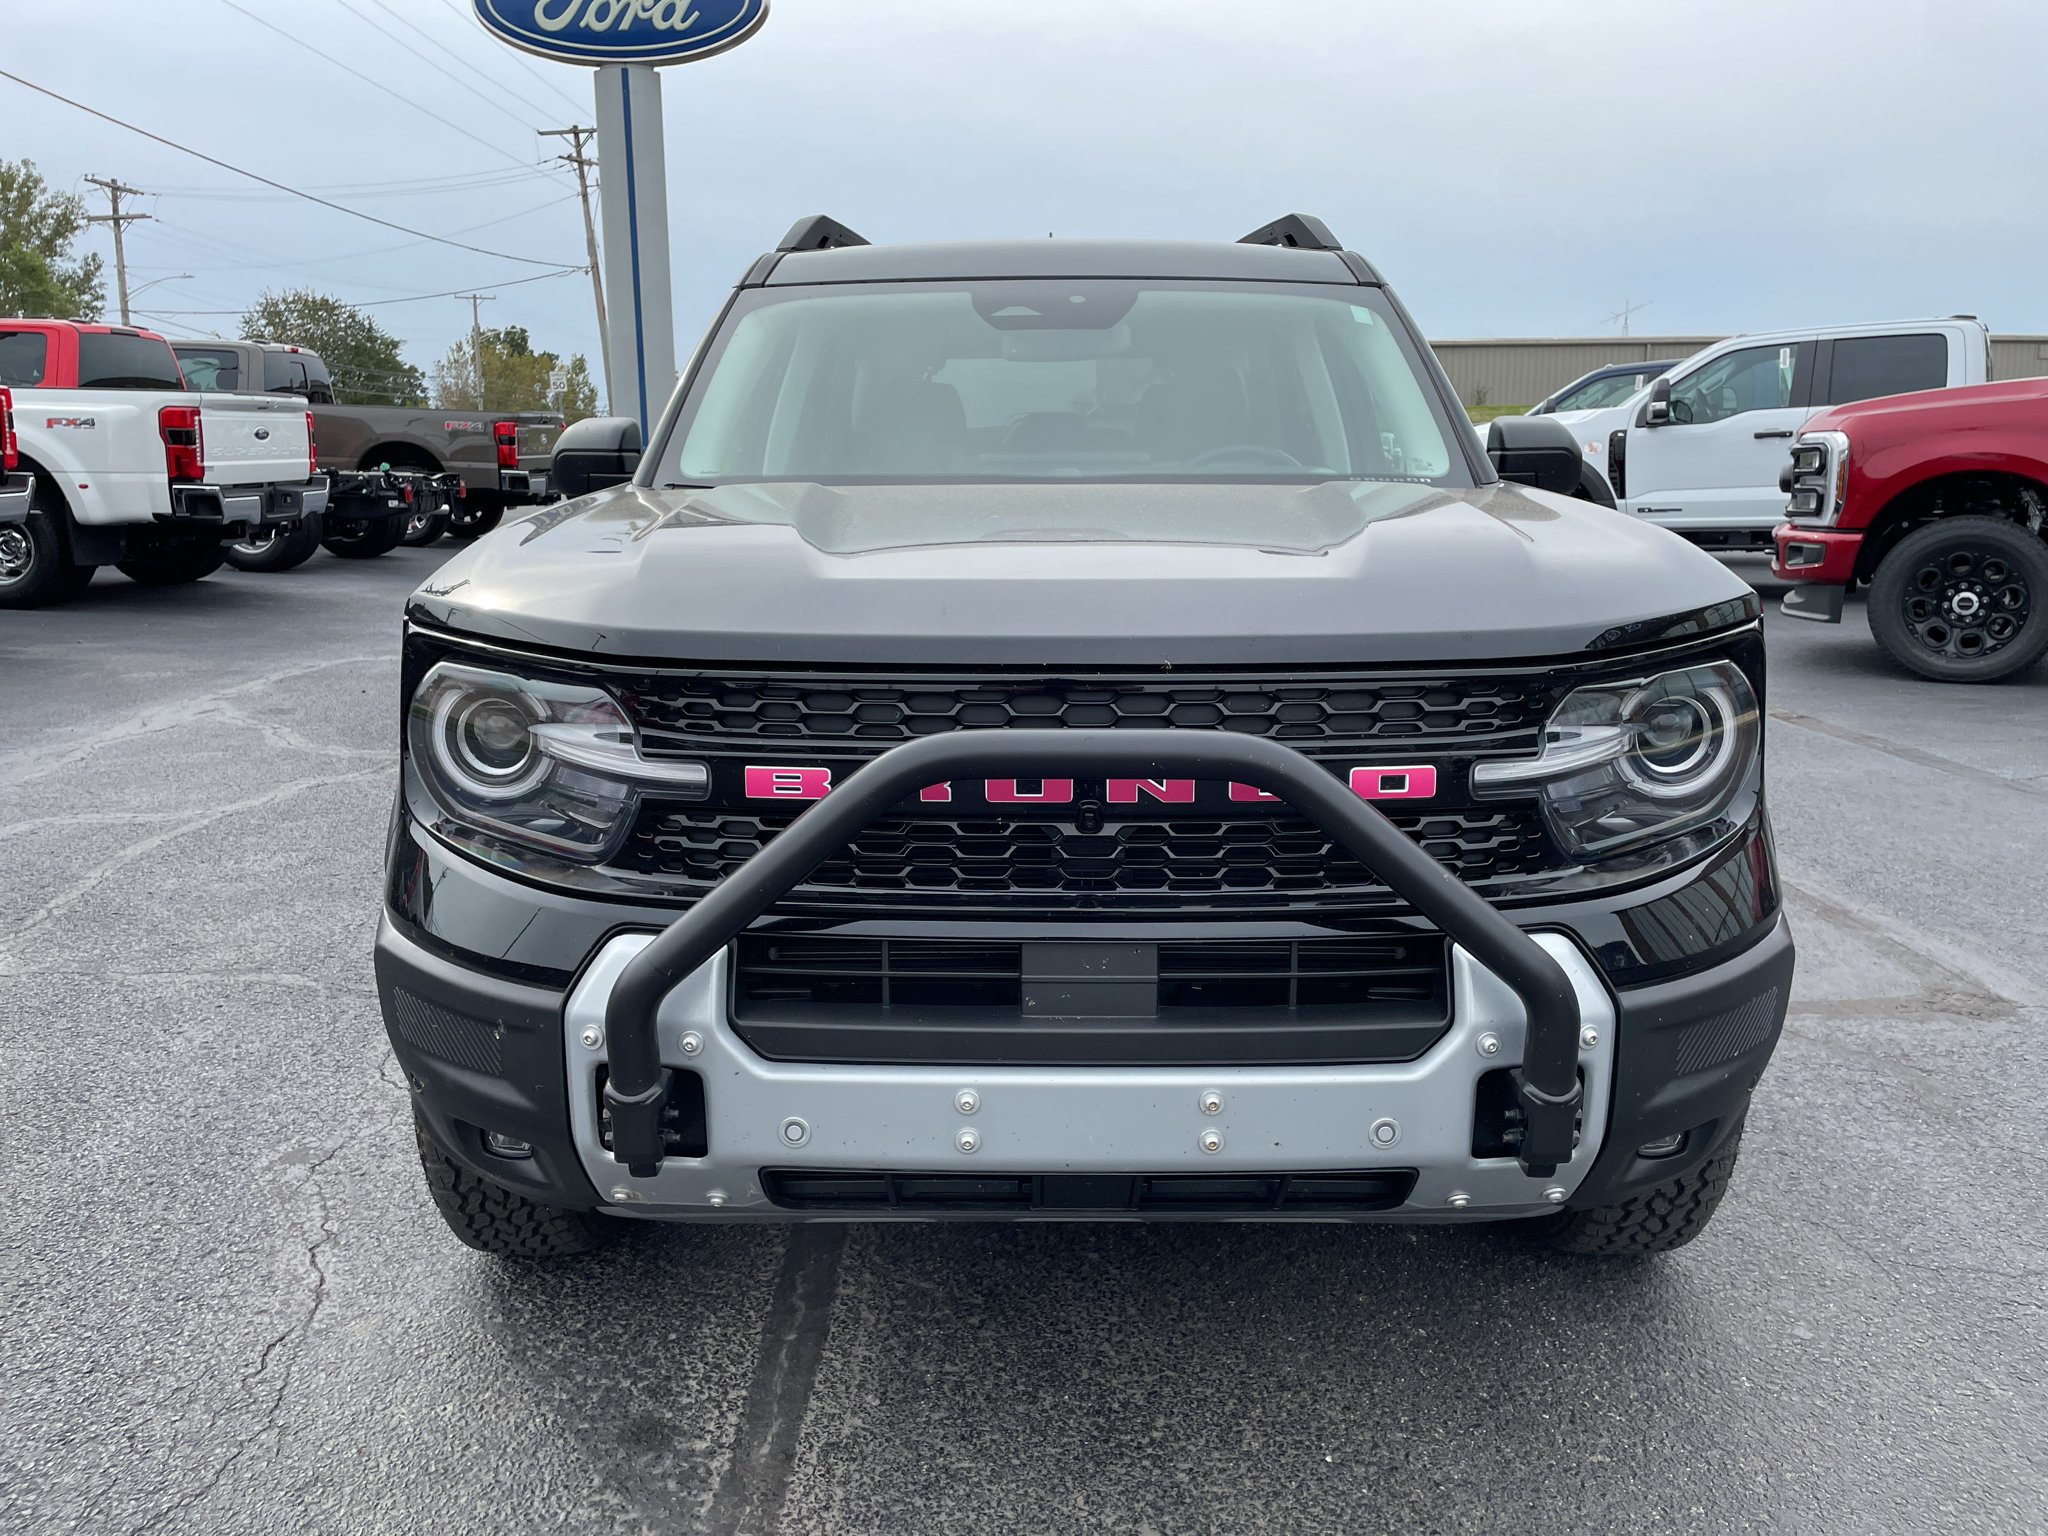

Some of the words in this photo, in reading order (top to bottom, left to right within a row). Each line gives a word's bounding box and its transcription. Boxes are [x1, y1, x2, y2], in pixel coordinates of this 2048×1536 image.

[552, 381, 566, 390] 50
[46, 417, 96, 429] FX4
[445, 421, 482, 431] FX4
[211, 446, 267, 456] SUPER
[271, 446, 305, 455] DUTY
[744, 764, 1438, 803] BONO
